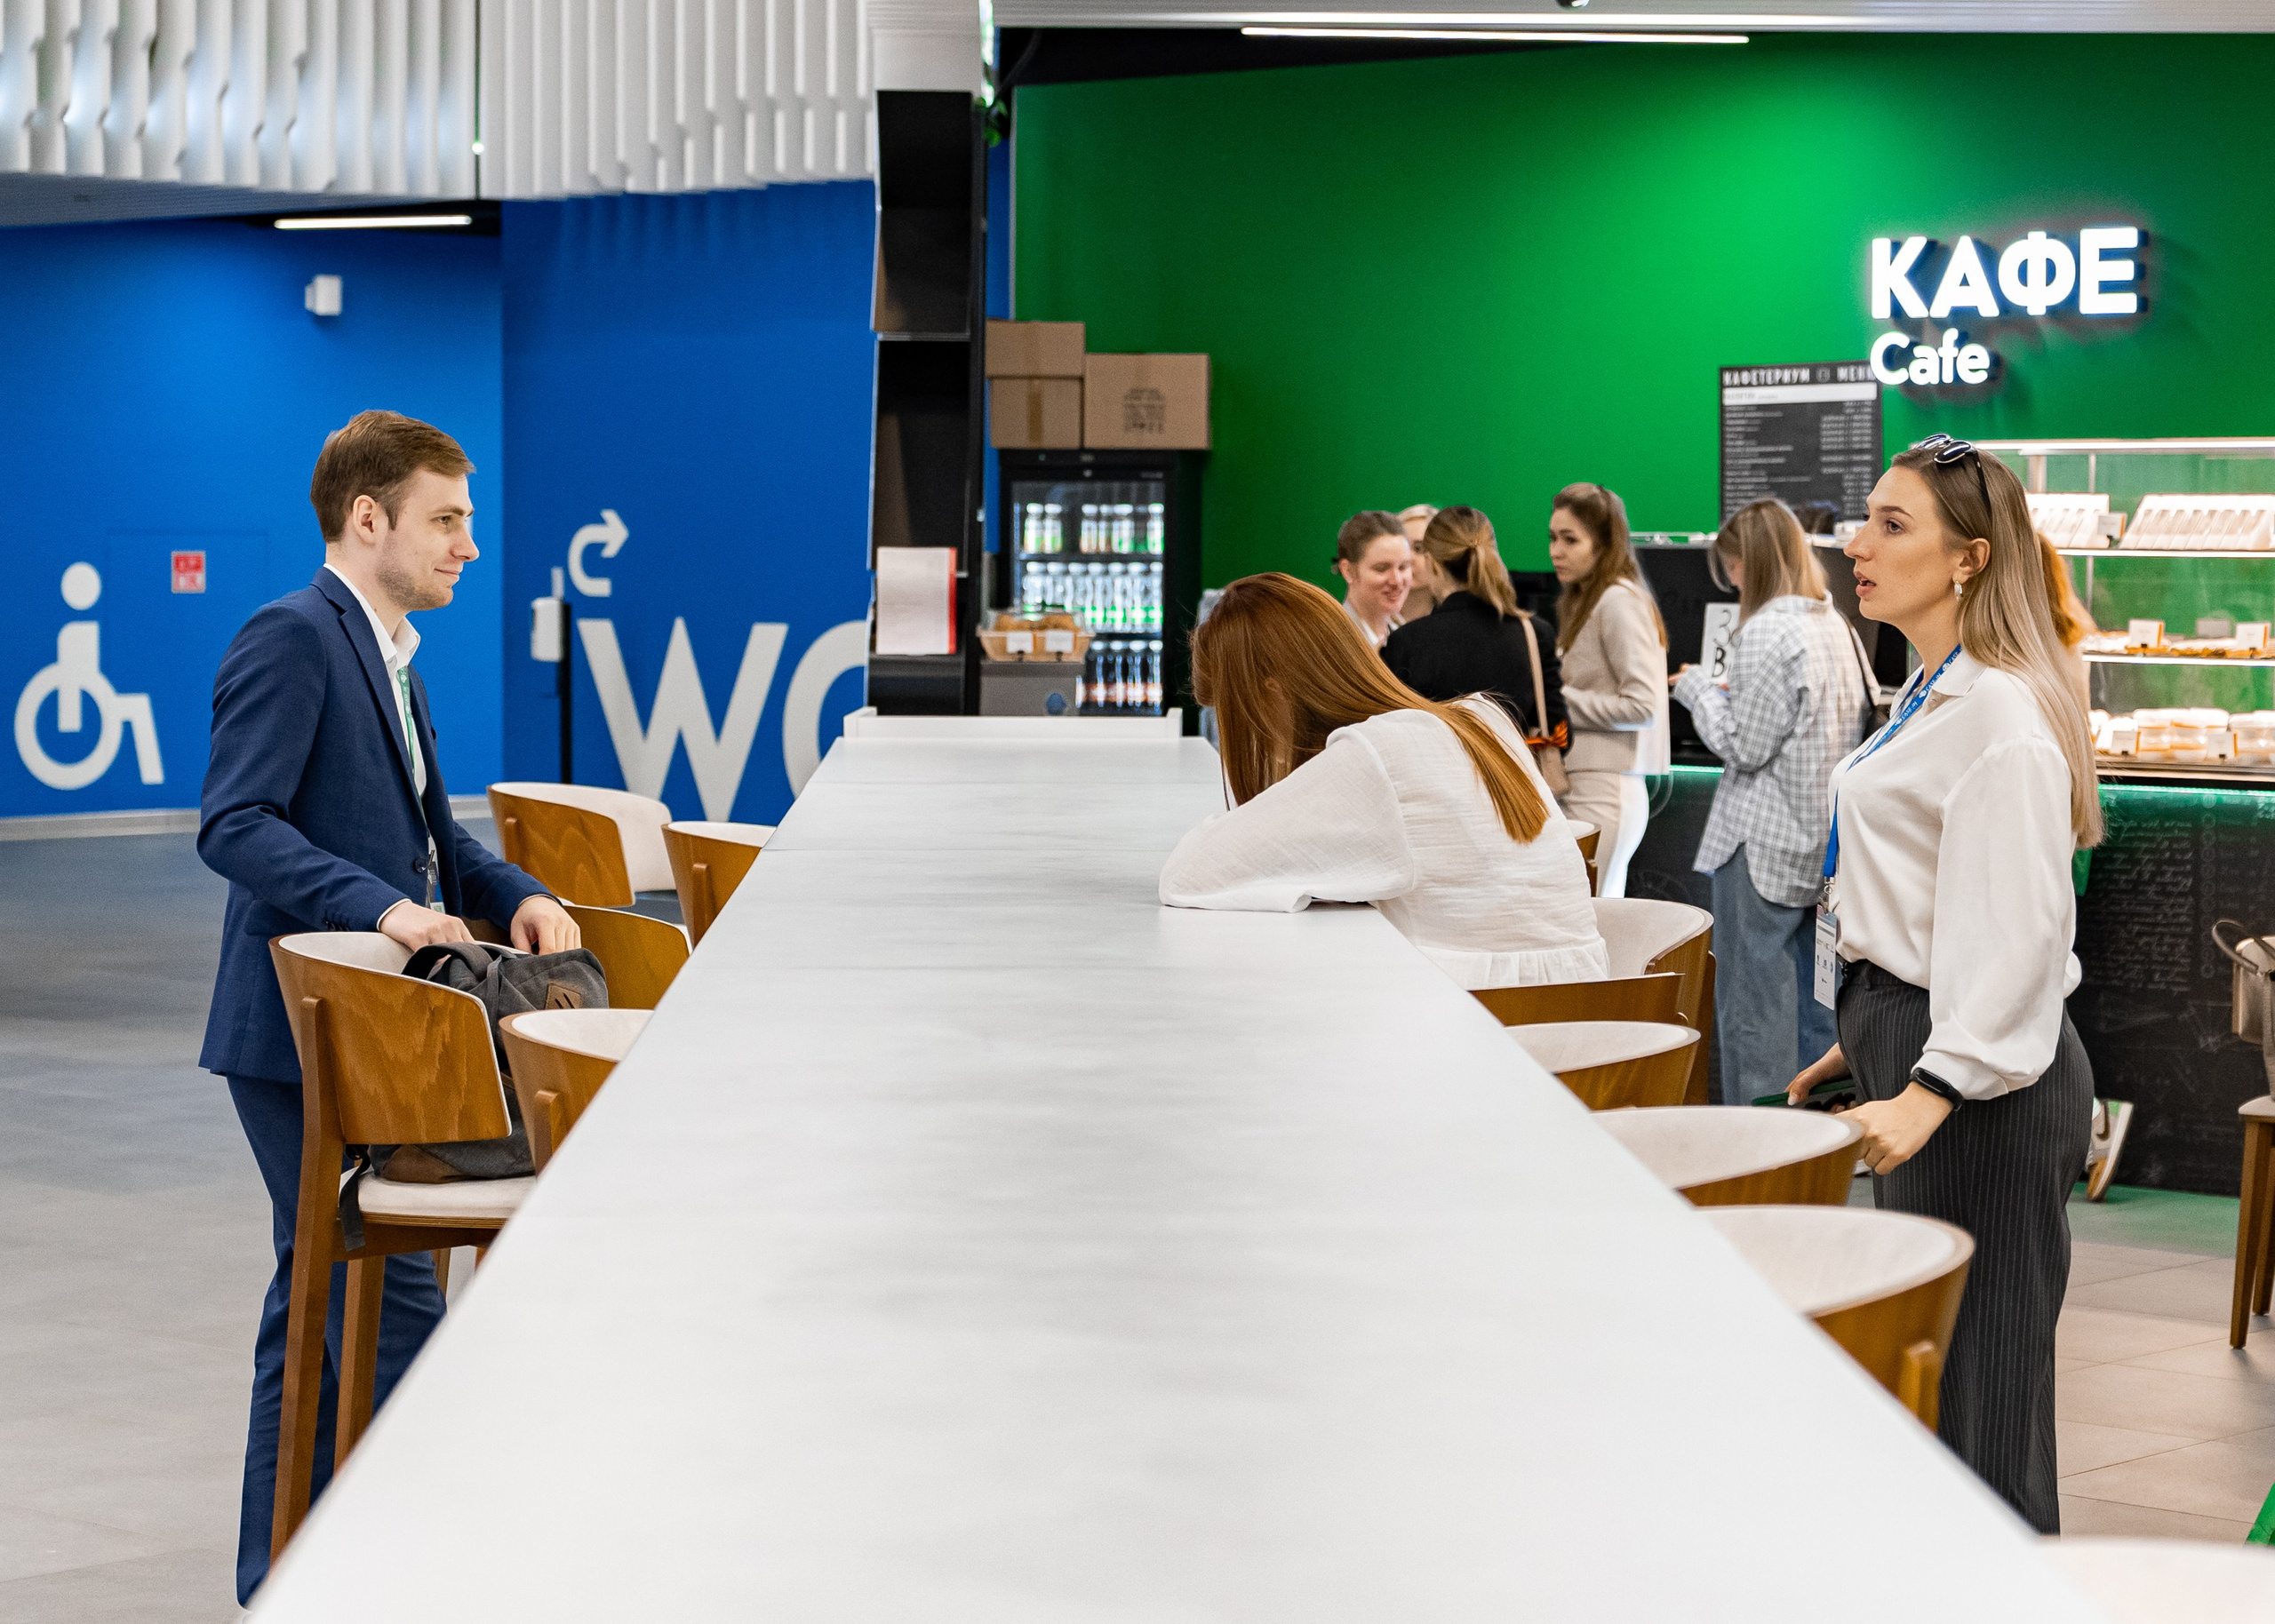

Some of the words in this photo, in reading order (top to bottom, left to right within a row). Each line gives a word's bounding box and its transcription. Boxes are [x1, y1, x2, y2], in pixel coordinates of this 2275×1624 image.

[1871, 226, 2139, 319] КАФЕ
[1722, 367, 1810, 386] КАФЕТЕРИУМ
[1869, 327, 1991, 386] Cafe
